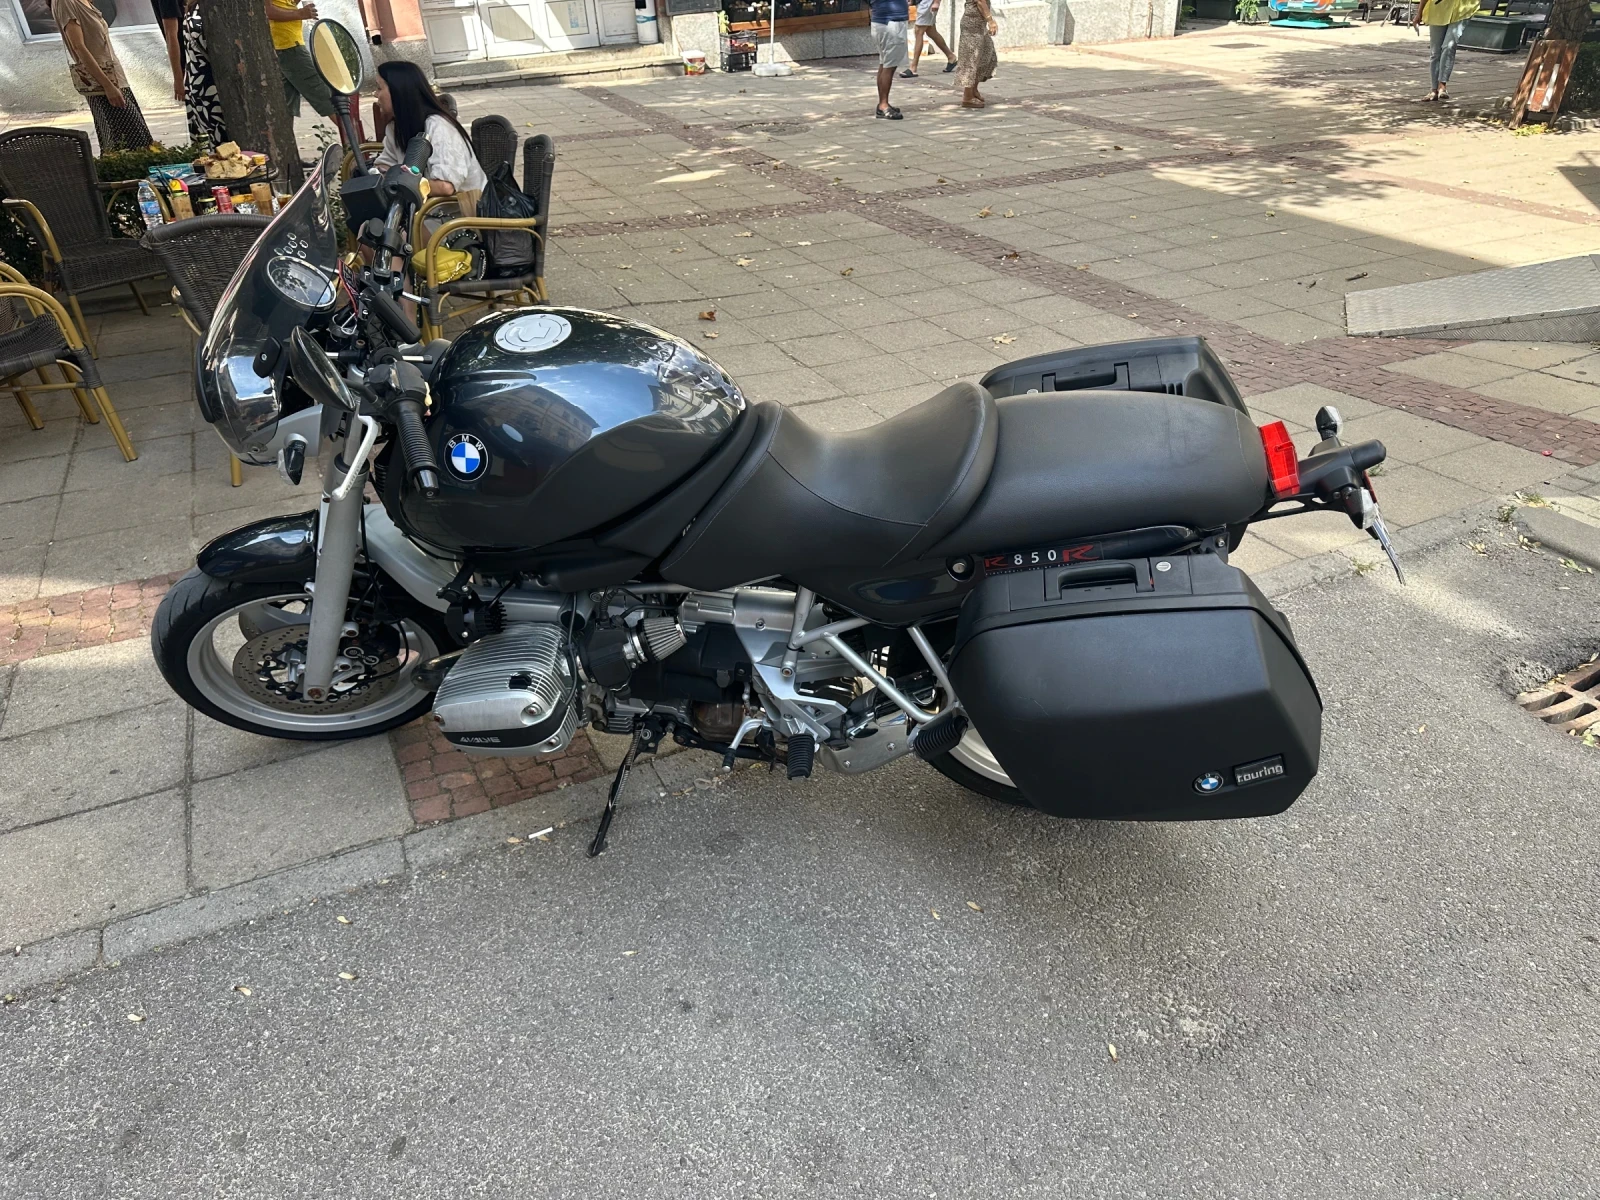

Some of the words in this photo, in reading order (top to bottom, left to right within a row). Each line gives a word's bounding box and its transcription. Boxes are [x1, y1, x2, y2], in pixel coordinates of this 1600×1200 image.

[448, 434, 484, 450] BMW
[1014, 549, 1057, 566] 850
[1062, 544, 1100, 563] R
[1237, 764, 1284, 783] touring
